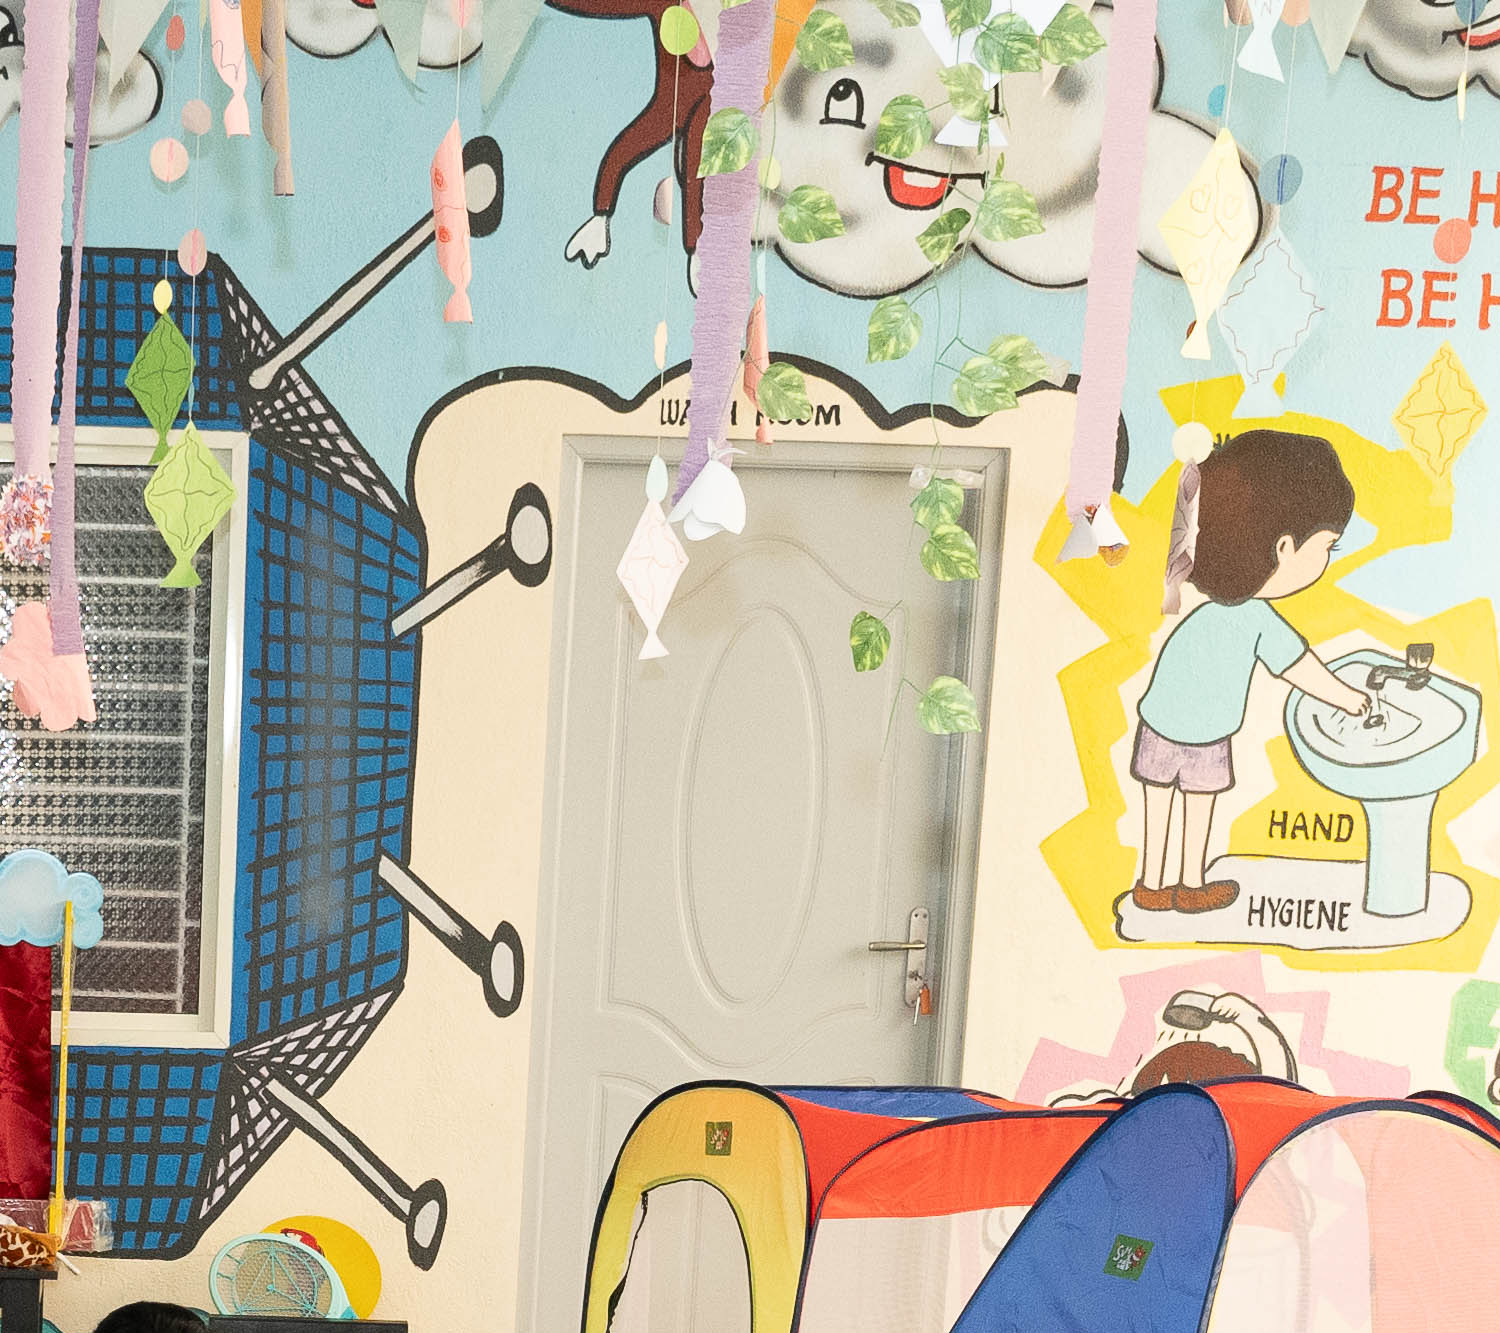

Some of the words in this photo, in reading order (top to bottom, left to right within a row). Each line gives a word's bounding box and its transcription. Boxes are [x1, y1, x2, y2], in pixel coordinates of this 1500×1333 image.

[1364, 165, 1444, 224] BE
[1376, 268, 1458, 328] BE
[1267, 809, 1355, 843] HAND
[1247, 894, 1352, 932] HYGIENE
